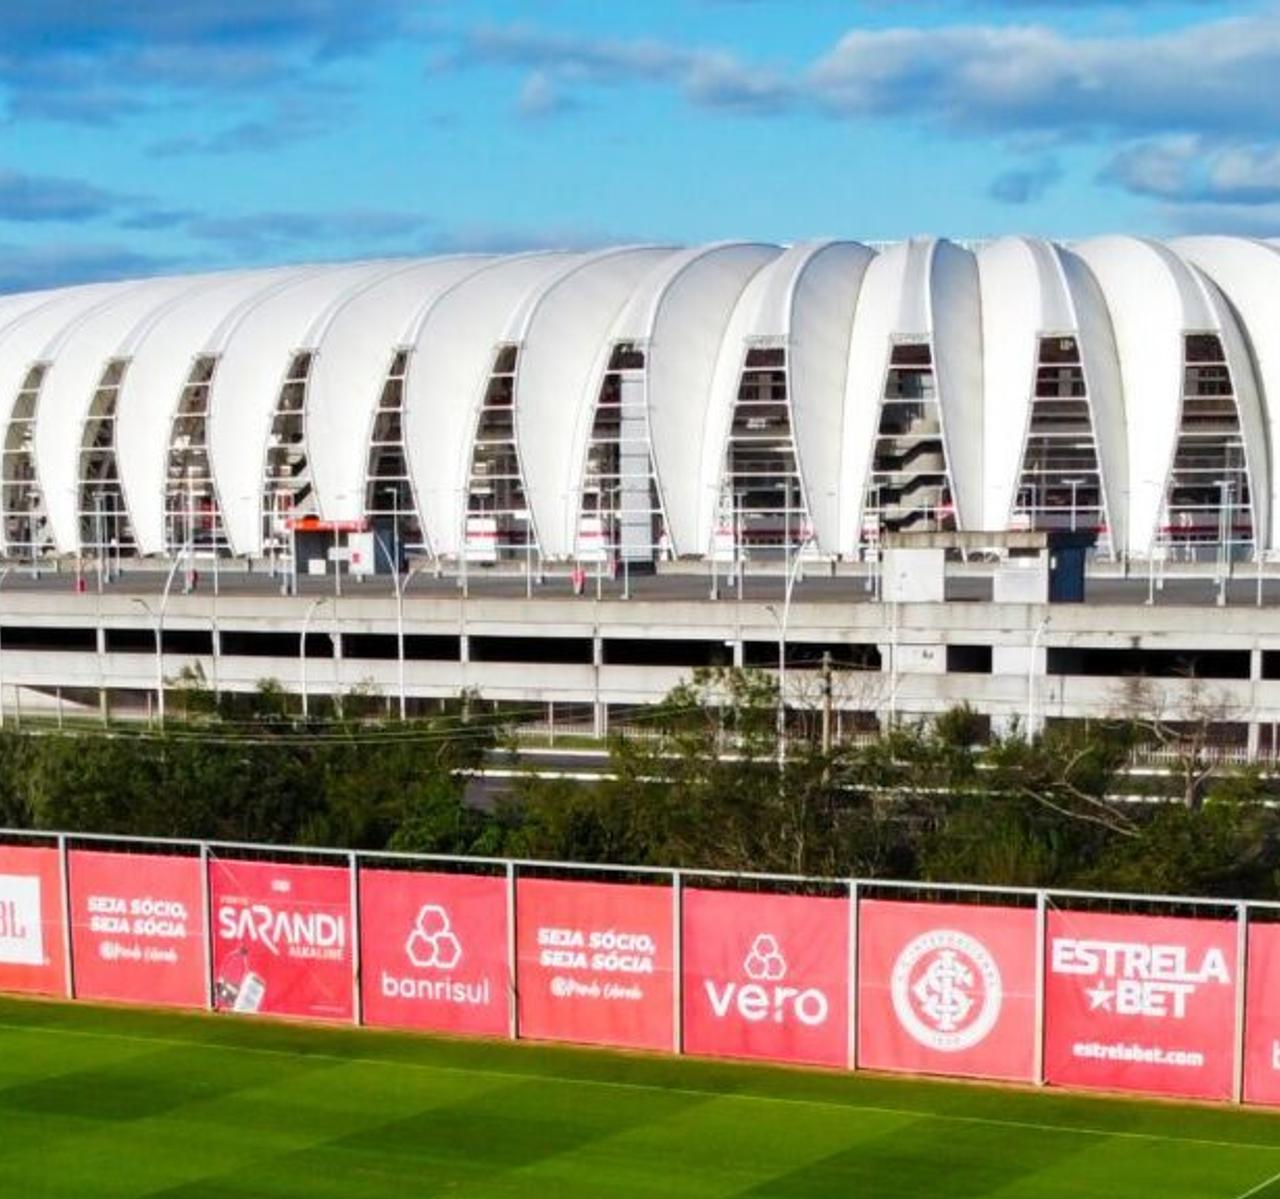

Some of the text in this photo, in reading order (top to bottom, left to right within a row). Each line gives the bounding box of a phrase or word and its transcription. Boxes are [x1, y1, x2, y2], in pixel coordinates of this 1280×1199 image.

[87, 896, 188, 921] SEJA SÓCIO,
[90, 915, 187, 939] SEJA SÓCIA
[218, 904, 346, 956] SARANDI
[538, 928, 655, 955] SEJA SÓCIO,
[541, 950, 654, 974] SEJA SÓCIA
[1052, 937, 1231, 983] ESTRELA
[380, 970, 489, 1005] banrisul
[704, 979, 828, 1025] vero
[1116, 979, 1194, 1018] BET
[1073, 1041, 1204, 1067] estrelabet.com
